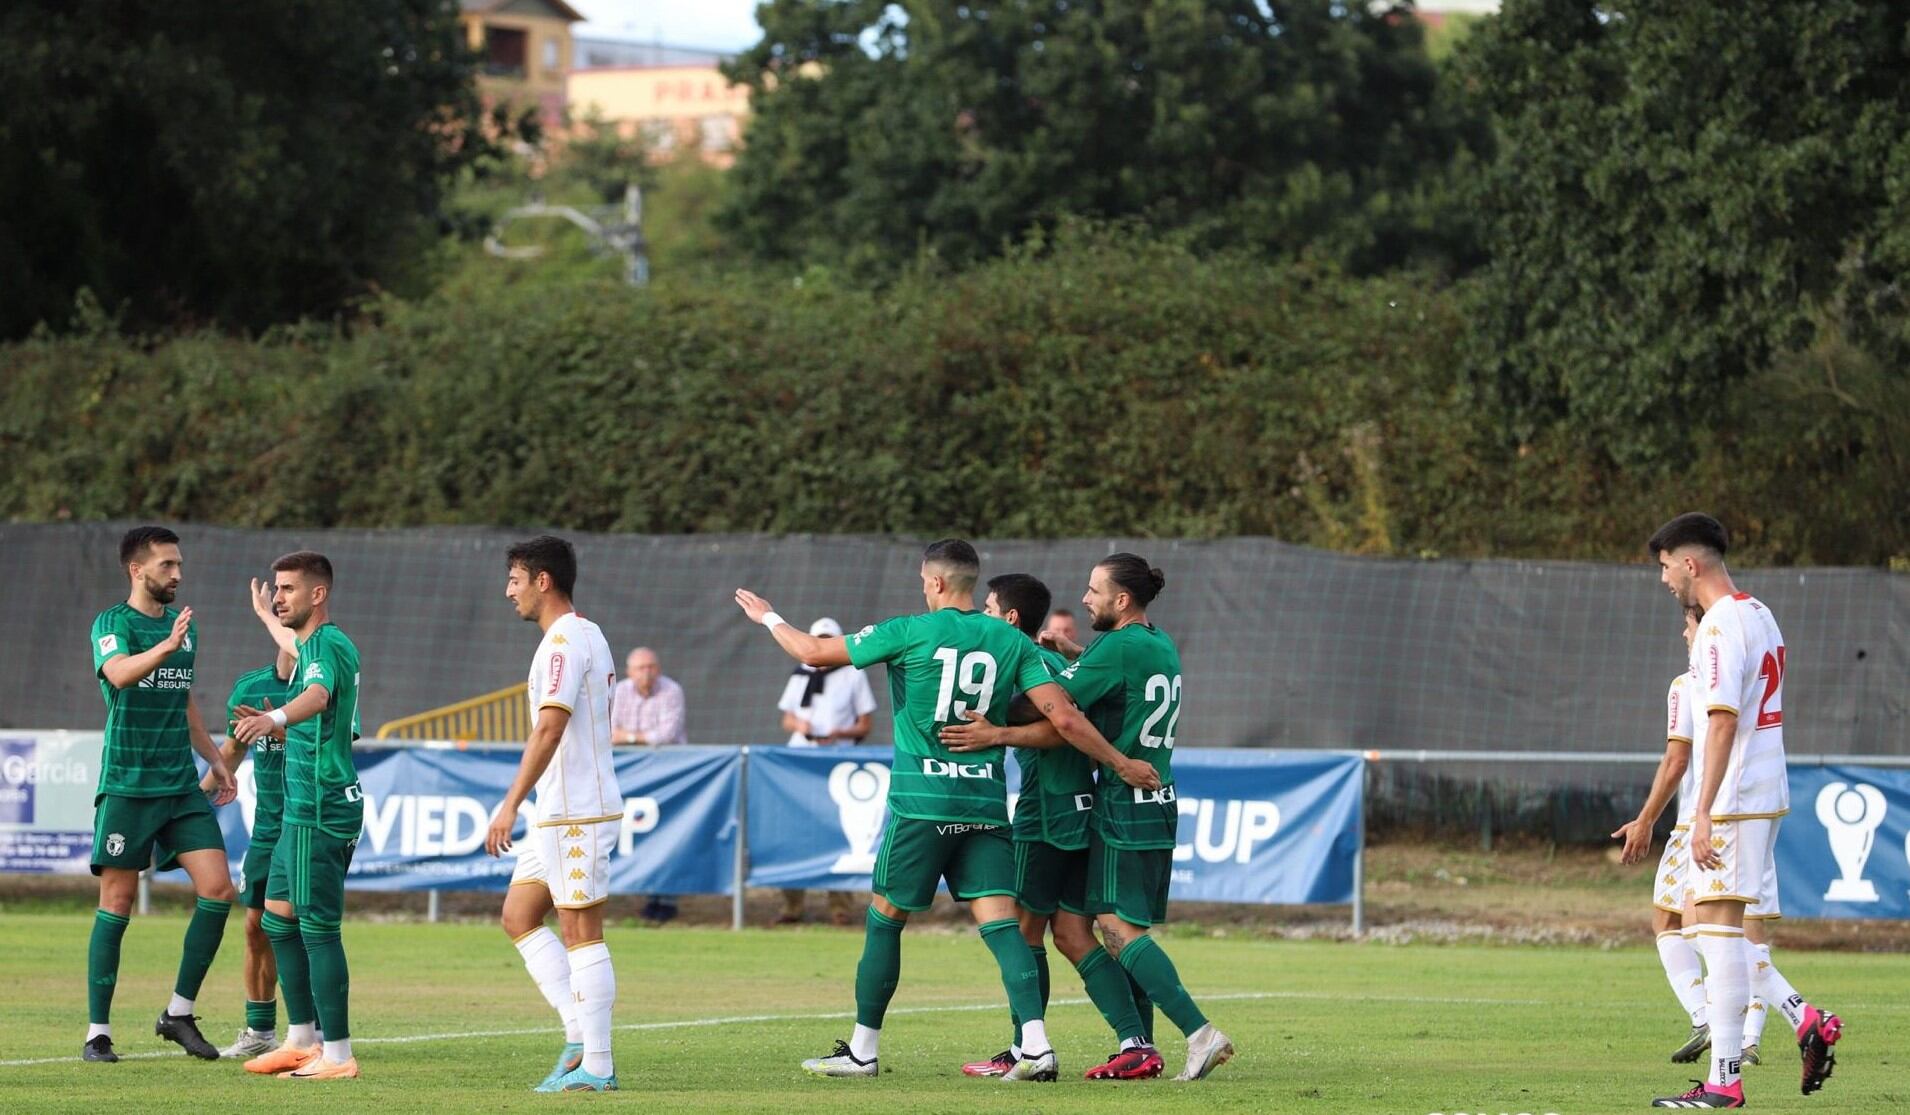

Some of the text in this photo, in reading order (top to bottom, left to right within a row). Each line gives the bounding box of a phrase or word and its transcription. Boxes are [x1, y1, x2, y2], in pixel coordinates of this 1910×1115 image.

[158, 668, 192, 679] REALE
[932, 647, 997, 721] 19
[1139, 674, 1181, 748] 22
[923, 759, 992, 779] DIGI
[1173, 797, 1281, 864] CUP
